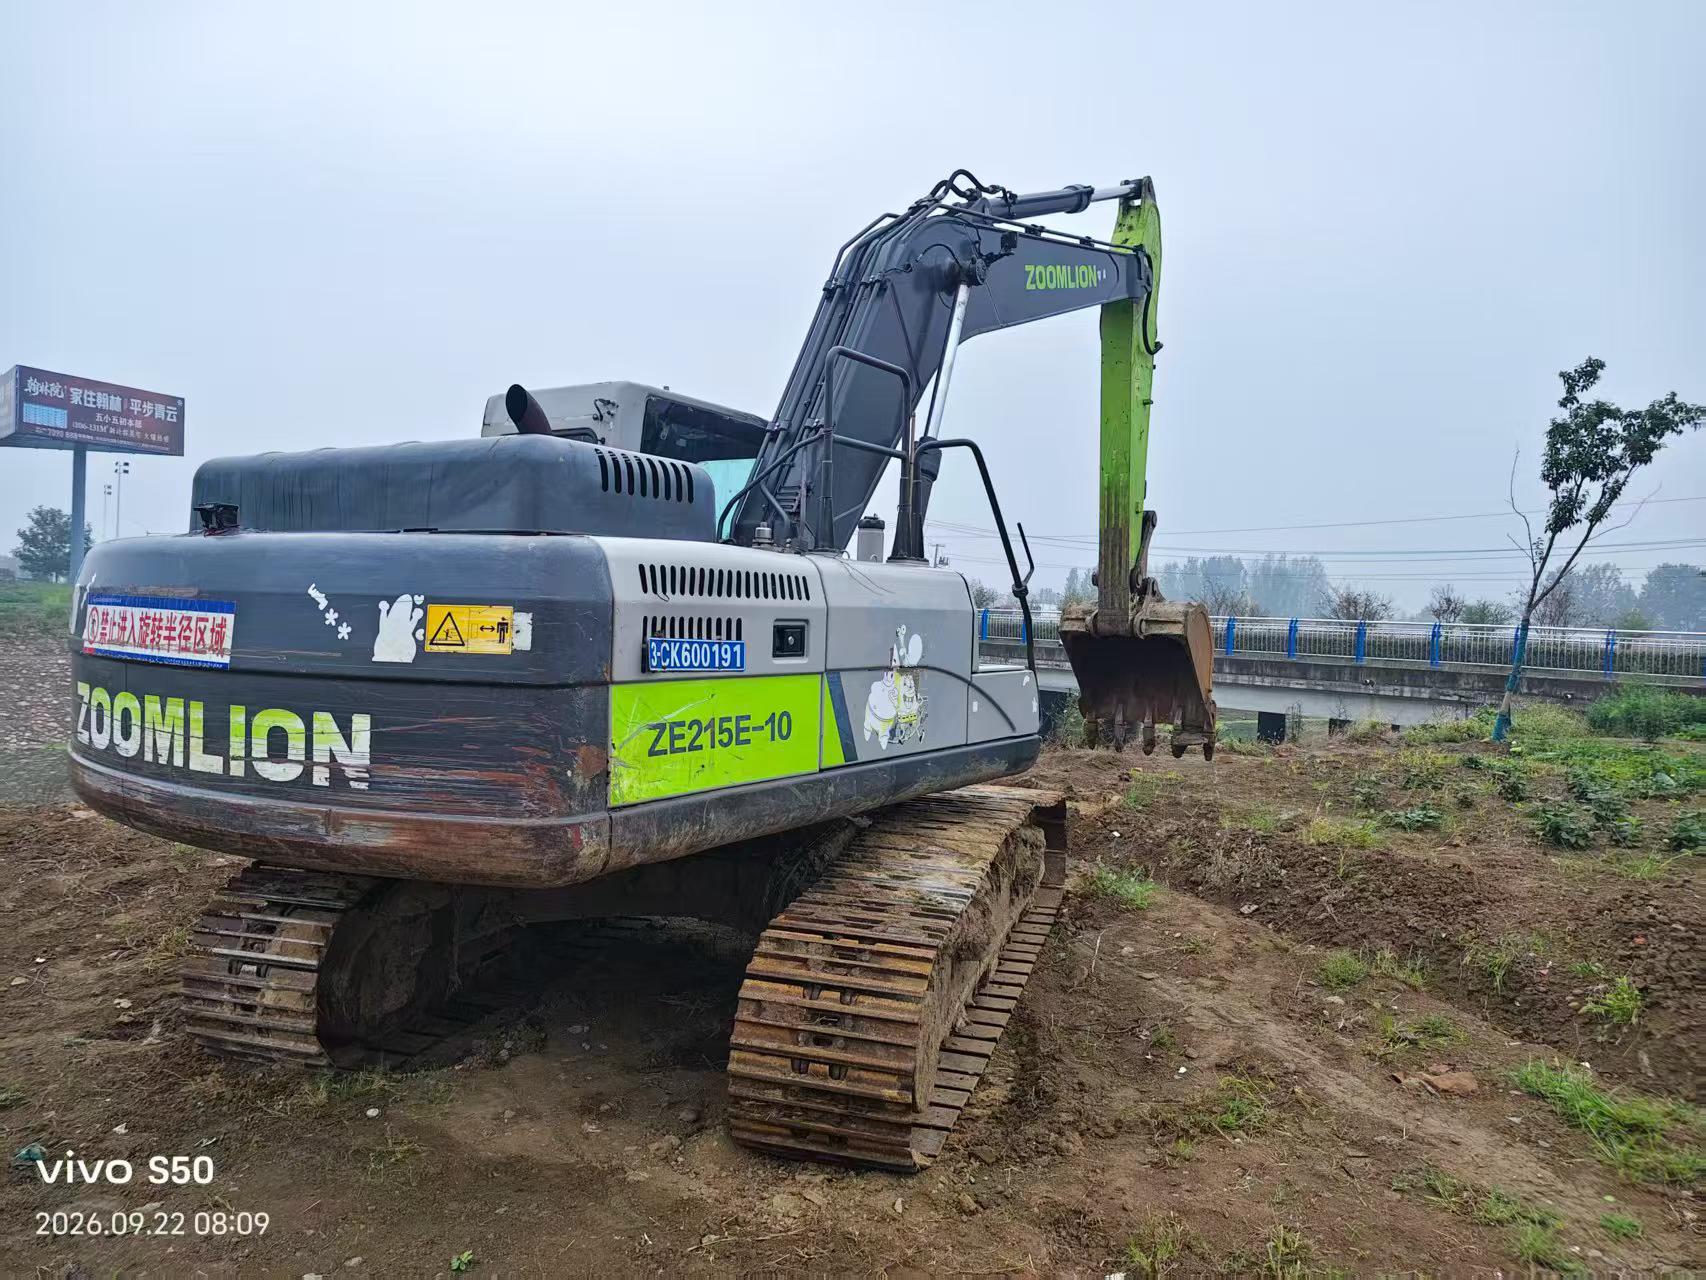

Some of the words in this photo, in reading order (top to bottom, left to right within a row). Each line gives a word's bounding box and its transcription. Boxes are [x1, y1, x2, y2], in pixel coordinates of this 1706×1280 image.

[1024, 264, 1098, 290] ZOOMLION
[130, 398, 178, 423] 平步青云
[99, 608, 227, 658] 禁止进入旋转半径区域
[651, 641, 741, 668] 3-CK600191
[76, 681, 372, 790] ZOOMLION
[647, 710, 792, 757] ZE215E-10
